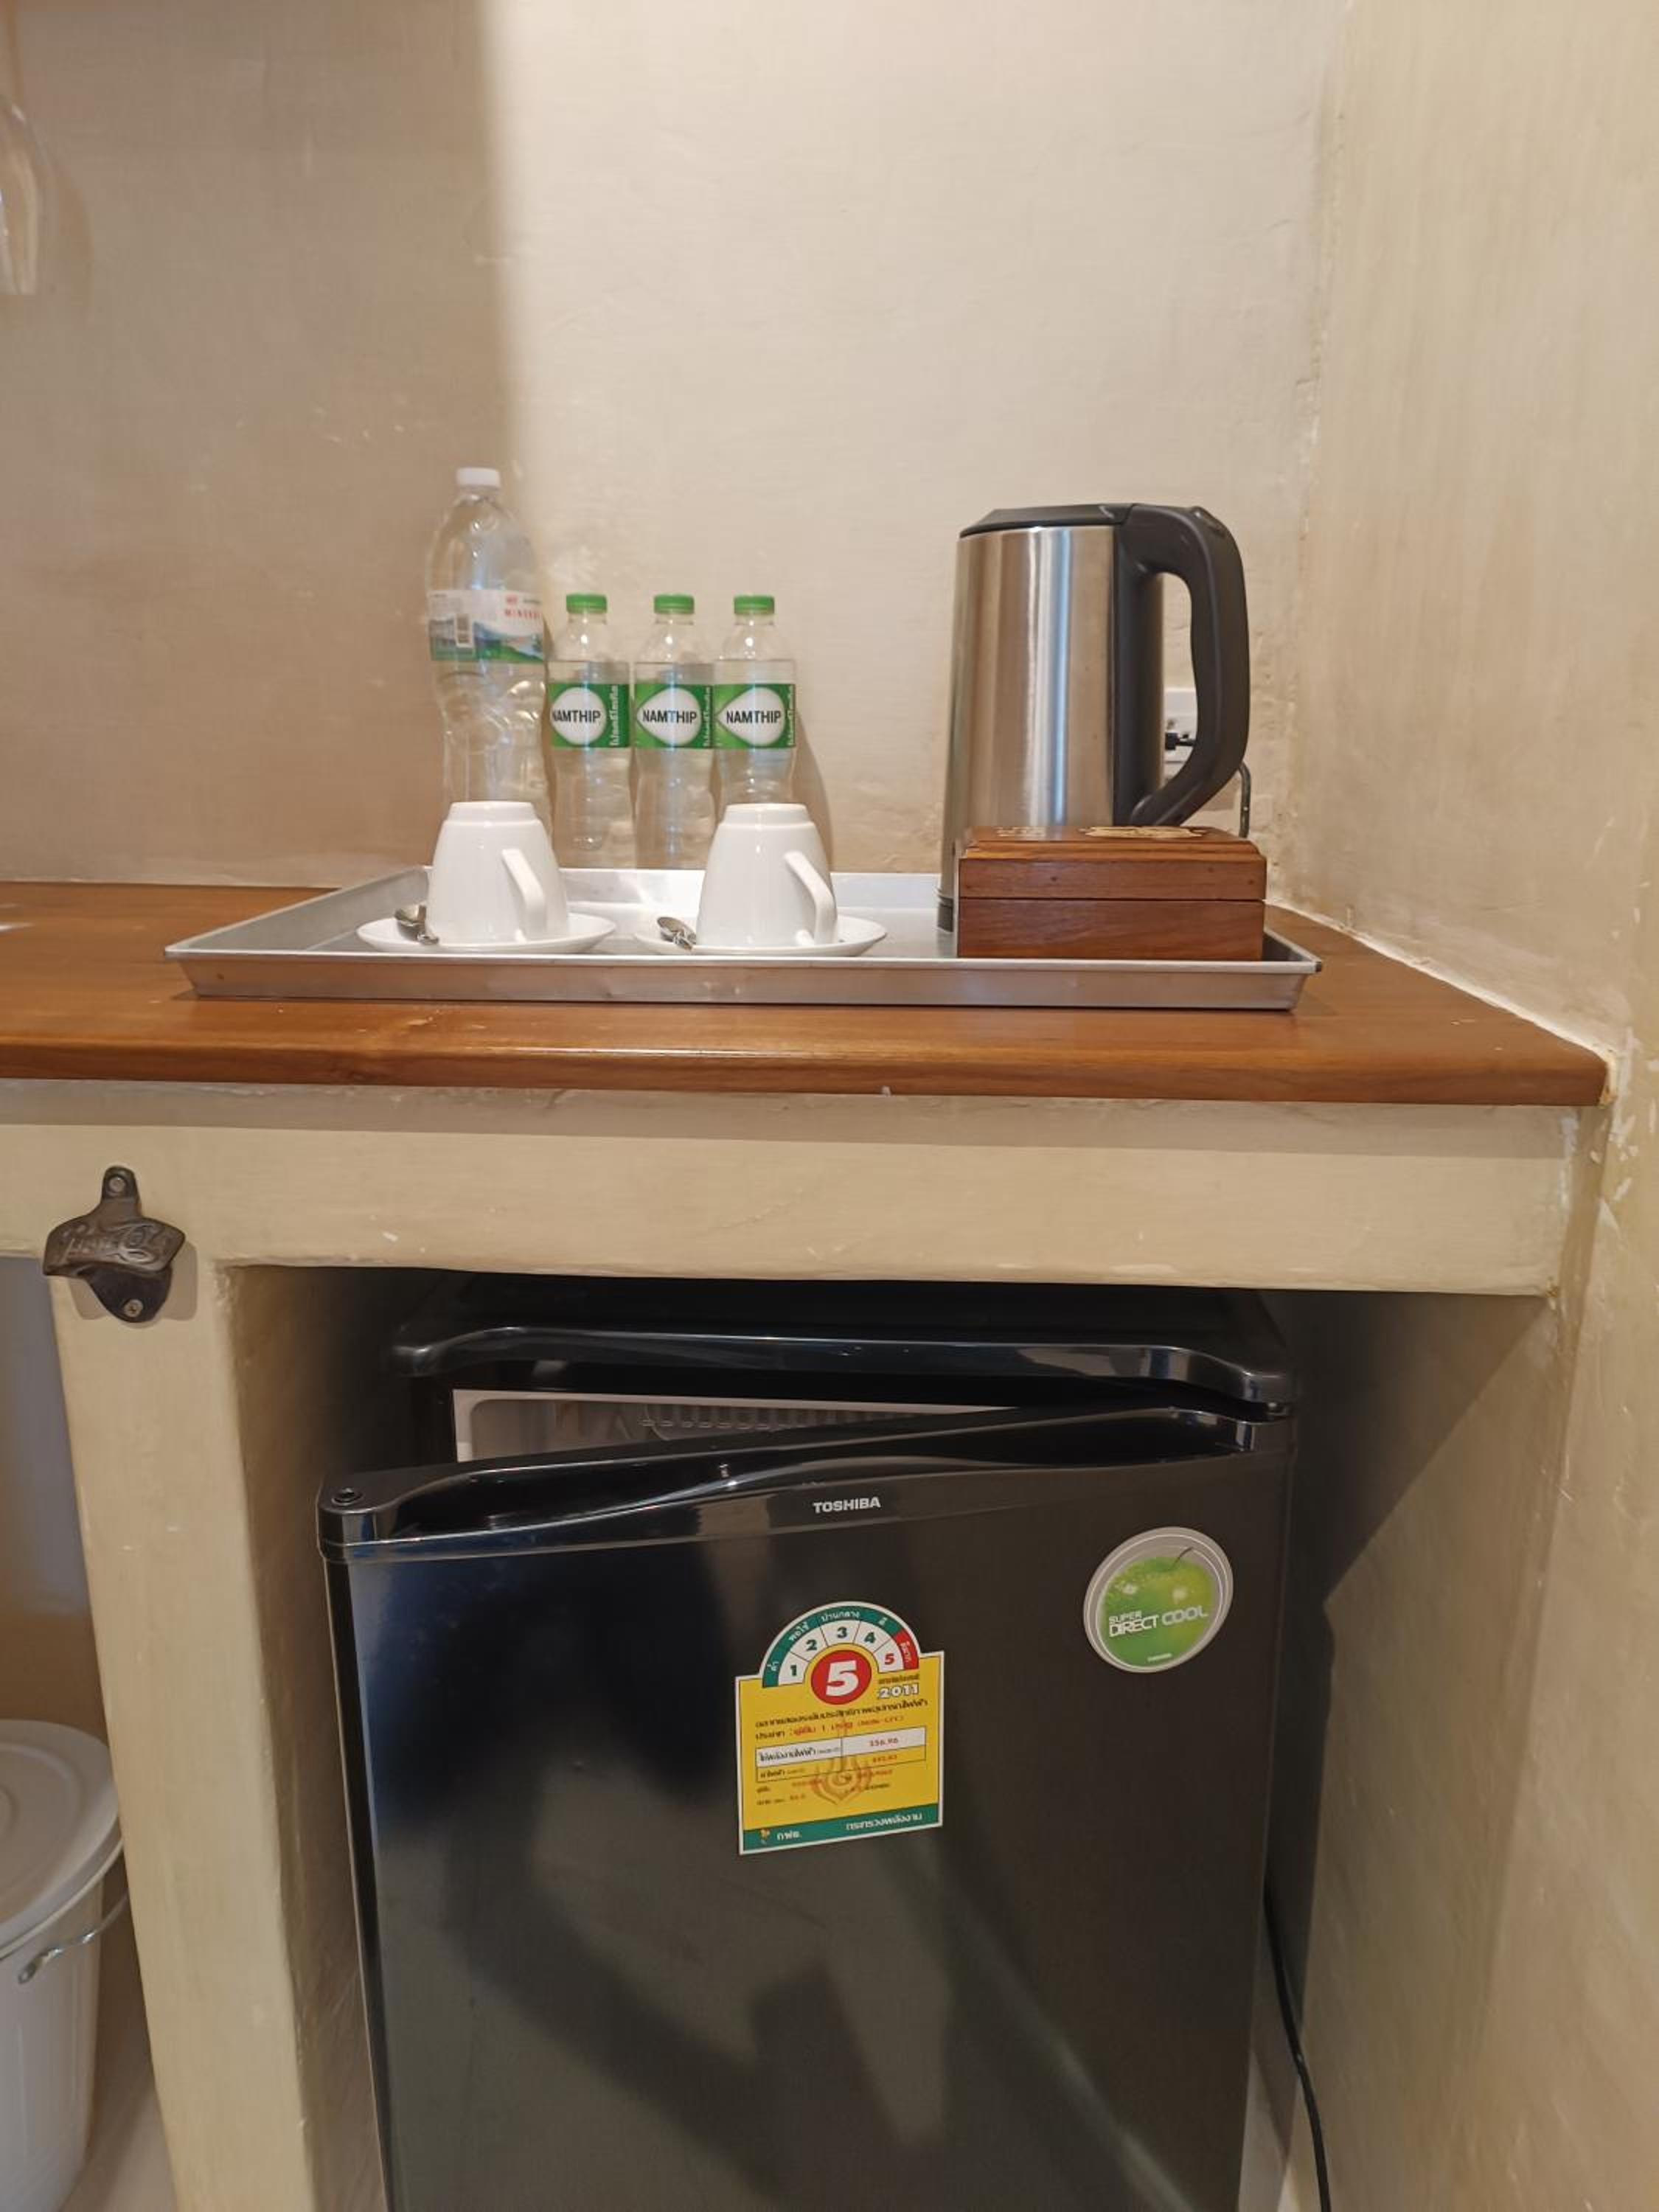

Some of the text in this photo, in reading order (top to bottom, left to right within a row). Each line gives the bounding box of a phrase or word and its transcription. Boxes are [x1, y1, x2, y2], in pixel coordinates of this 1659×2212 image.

[642, 709, 698, 724] NAMTHIP
[726, 710, 782, 724] NAMTHIP
[813, 1497, 881, 1513] TOSHIBA
[1108, 1610, 1142, 1625] SUPER
[1108, 1605, 1208, 1637] DIRECT COOL
[790, 1626, 895, 1677] 1 2 3 4 5
[826, 1660, 860, 1697] 5
[877, 1683, 919, 1700] 2011
